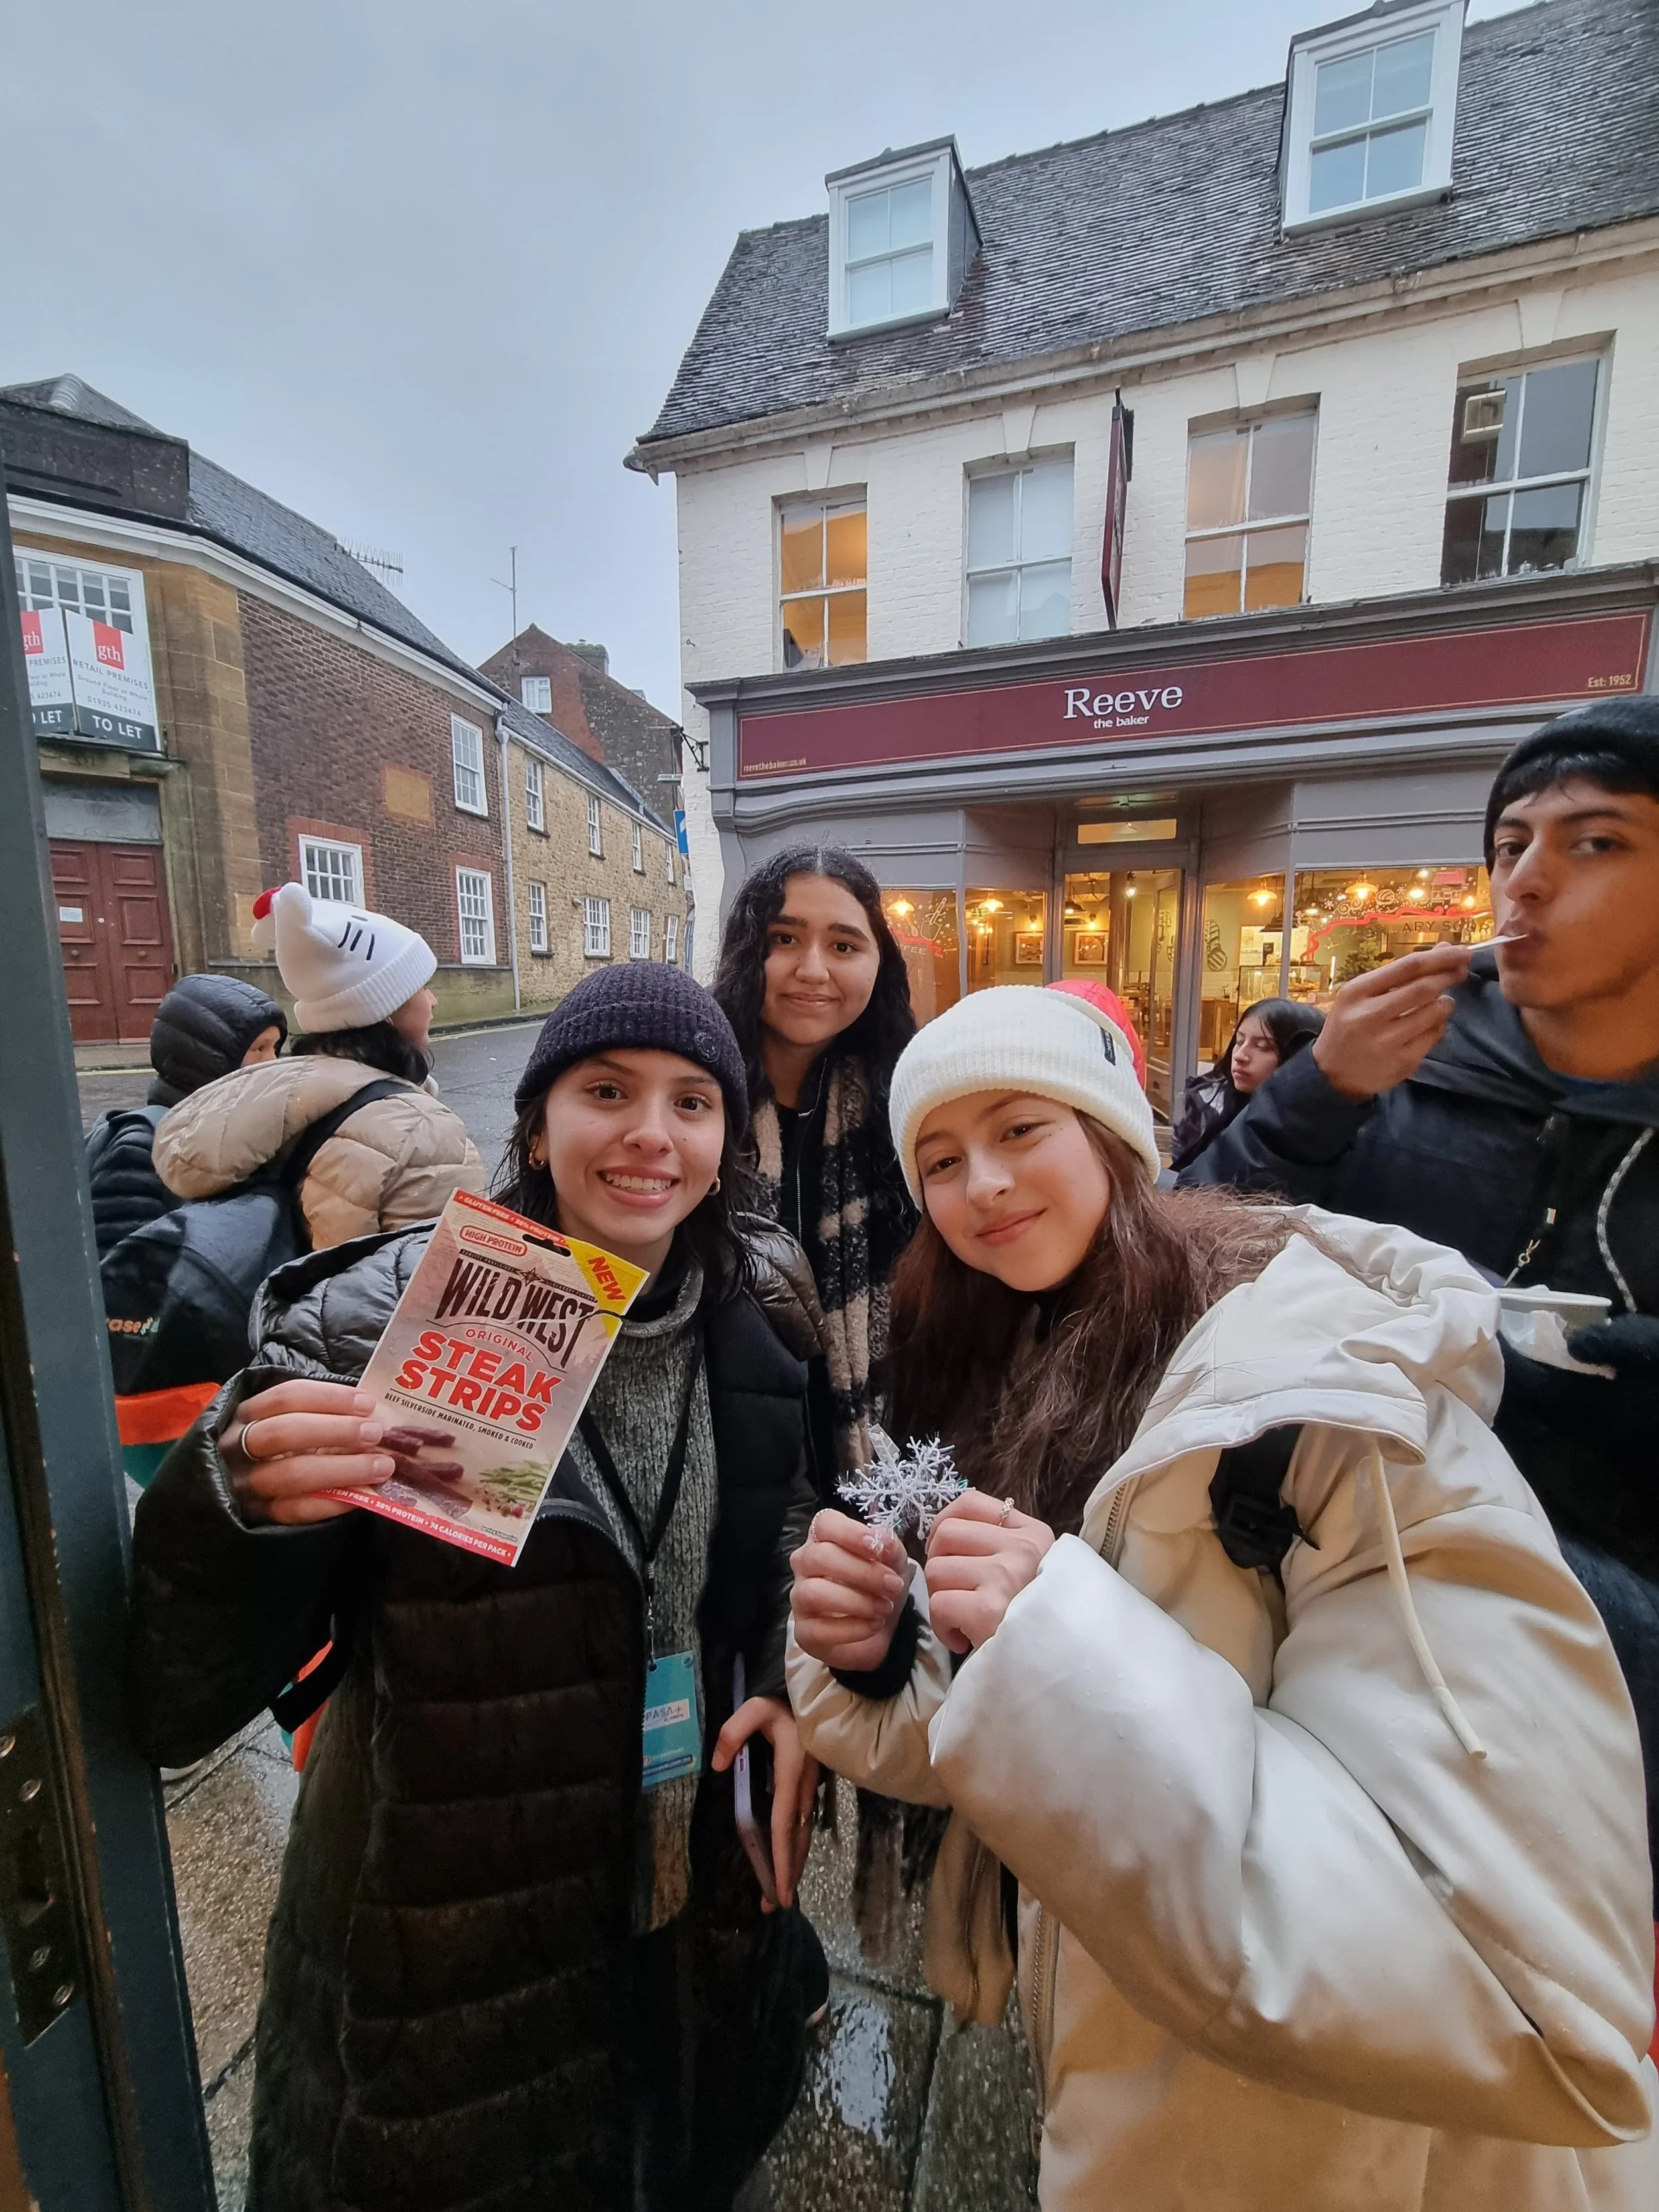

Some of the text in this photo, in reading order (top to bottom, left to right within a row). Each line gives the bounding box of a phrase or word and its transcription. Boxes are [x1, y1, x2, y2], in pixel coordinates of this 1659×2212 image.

[29, 656, 66, 666] PREMISES
[98, 645, 121, 662] gth
[73, 659, 149, 690] RETAIL PREMISES
[78, 674, 101, 686] Ground
[1609, 674, 1632, 686] 1952
[40, 710, 62, 725] LET
[87, 696, 111, 709] 01935
[1063, 686, 1183, 719] Reeve
[92, 715, 143, 739] TO LET
[1094, 715, 1150, 729] the baker
[465, 1197, 492, 1213] GLUTEN
[491, 1207, 510, 1220] FREE
[529, 1224, 560, 1242] PROTEIN
[465, 1229, 522, 1254] HIGH PROTEIN
[589, 1256, 627, 1301] NEW
[435, 1257, 595, 1368] WILD WEST
[466, 1329, 532, 1361] ORIGINAL
[411, 1330, 563, 1404] STEAK
[394, 1359, 546, 1432] STRIPS
[384, 1392, 399, 1404] BEEF
[400, 1398, 437, 1418] SILVERSIDE
[437, 1411, 476, 1432] MARINATED,
[477, 1426, 503, 1440] SMOKED
[510, 1438, 534, 1450] COOKED
[348, 1493, 370, 1503] FREE
[375, 1501, 392, 1512] 38%
[392, 1507, 425, 1524] PROTEIN
[429, 1521, 439, 1531] 74
[439, 1525, 474, 1545] CALORIES
[472, 1538, 487, 1550] PER
[487, 1545, 507, 1557] PACK
